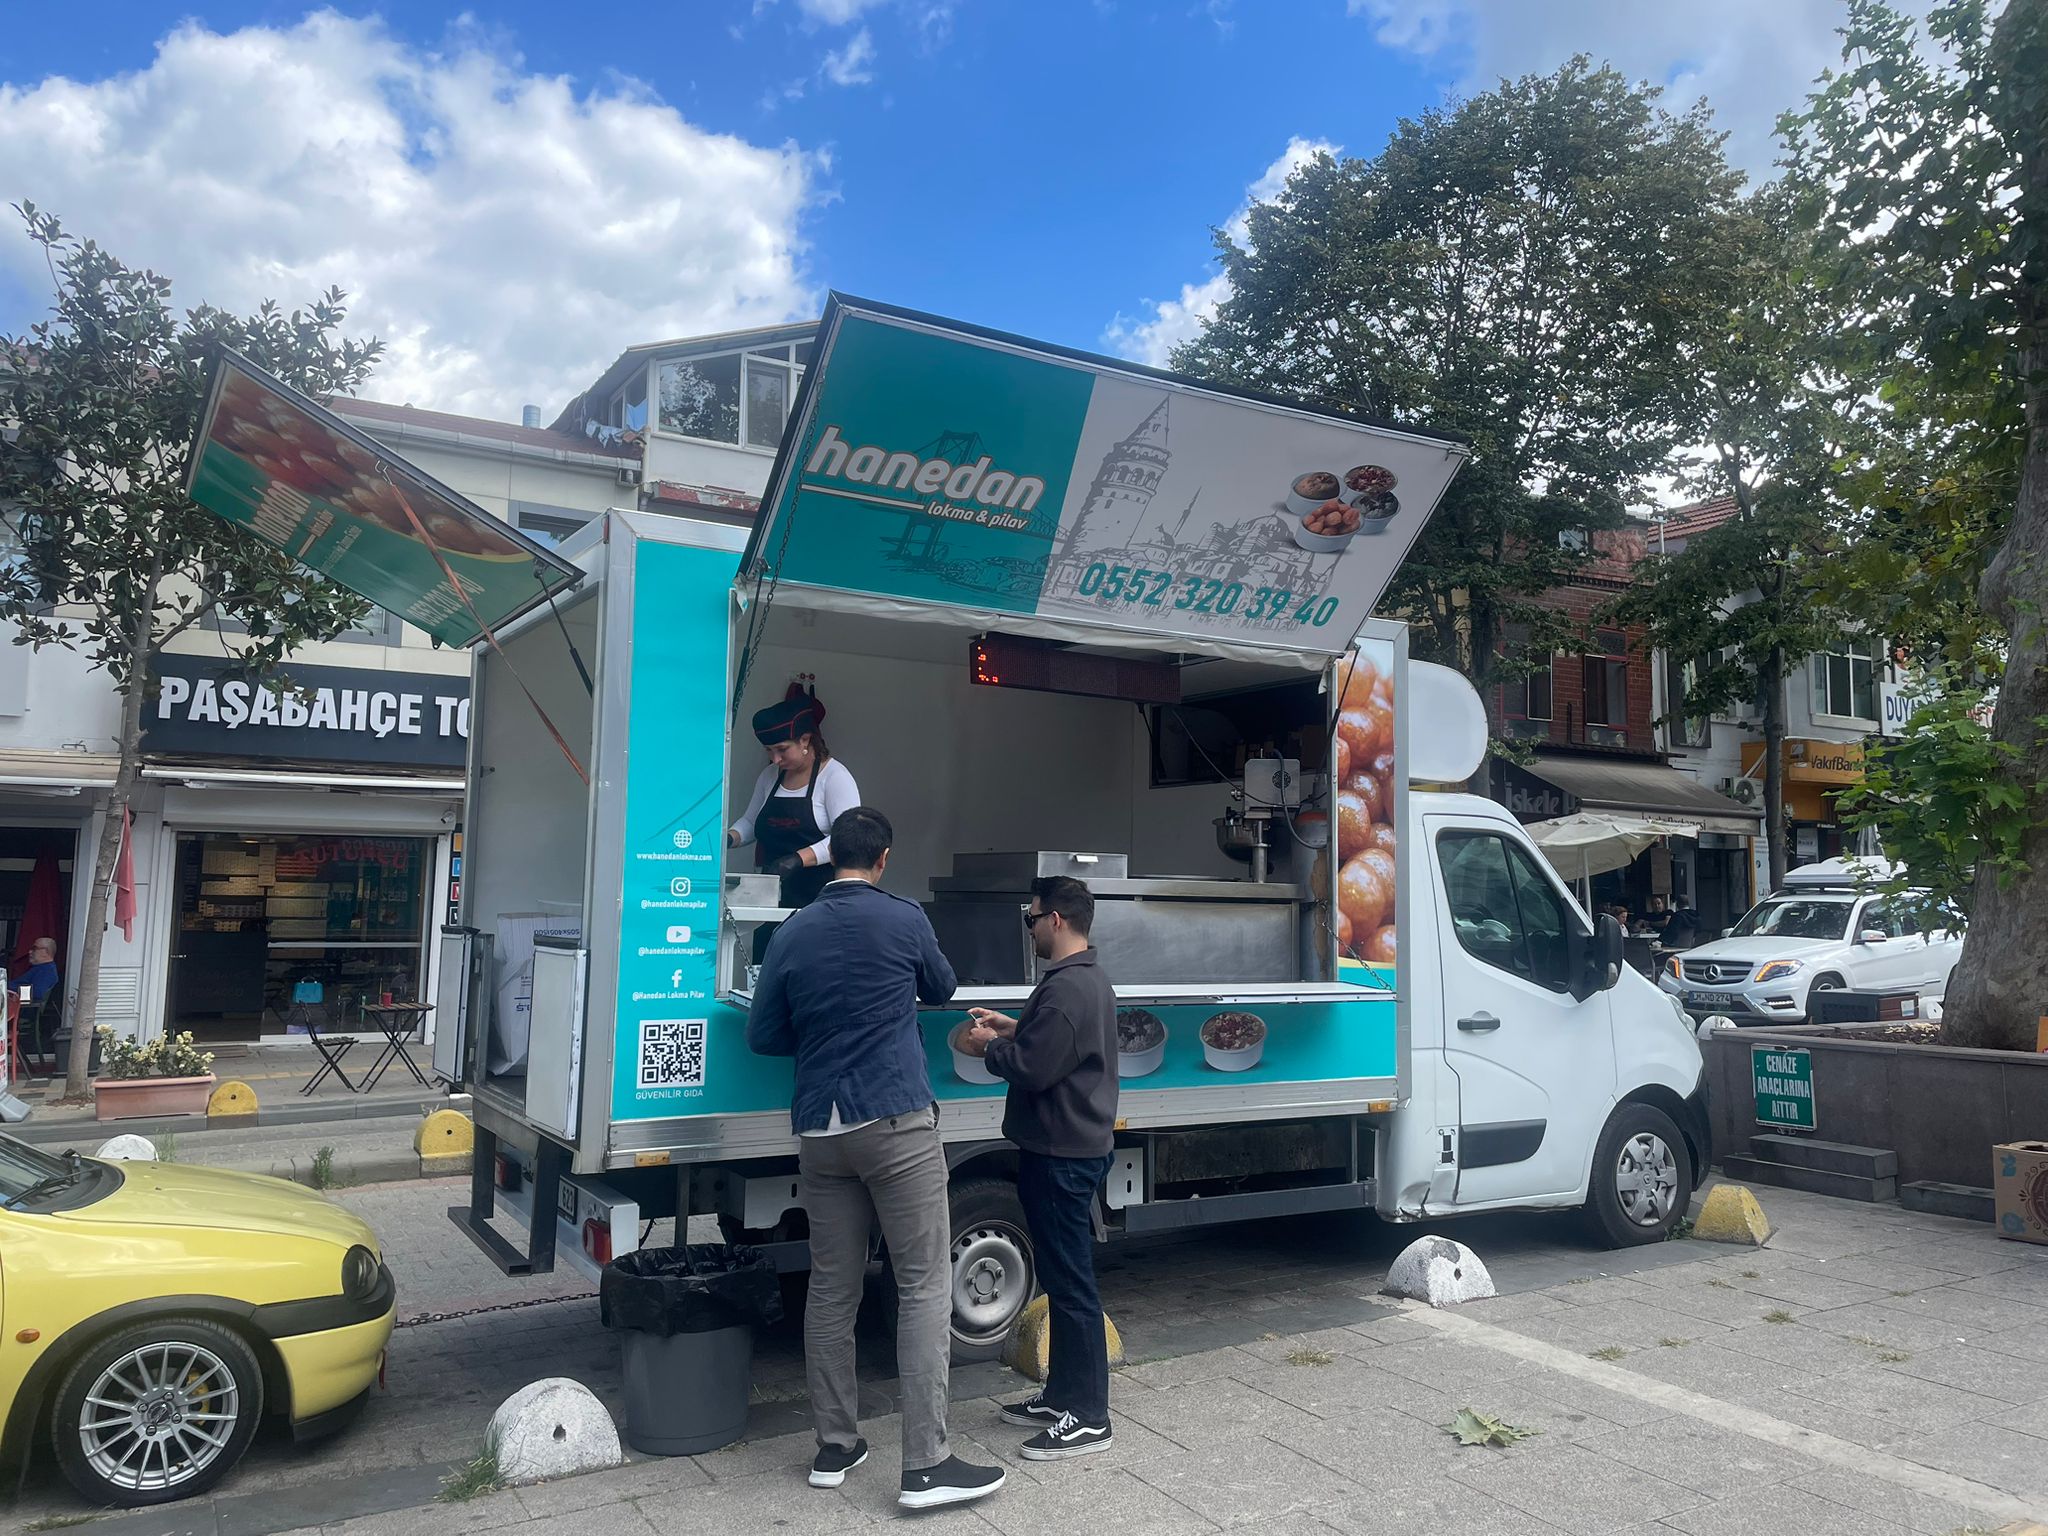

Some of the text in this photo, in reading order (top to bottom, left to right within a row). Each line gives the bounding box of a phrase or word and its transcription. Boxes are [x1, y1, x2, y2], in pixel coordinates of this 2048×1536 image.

[806, 426, 1045, 511] hanedan
[927, 501, 1028, 530] lokma & pilav
[1079, 562, 1339, 627] 0552 320 39 40
[158, 676, 422, 738] PAŞABAHÇE
[1811, 755, 1862, 771] VakıfBak
[636, 852, 712, 861] www.hanedanlokma.com
[641, 900, 708, 909] @hanedanlokmapilav
[638, 947, 705, 957] @hanedanlokmapilav
[667, 991, 688, 999] Lokma
[690, 990, 705, 999] Pilav
[1766, 1055, 1797, 1074] CENAZE
[635, 1089, 704, 1100] GÜVENİLİR GIDA
[1757, 1076, 1810, 1098] ARAÇLARINA
